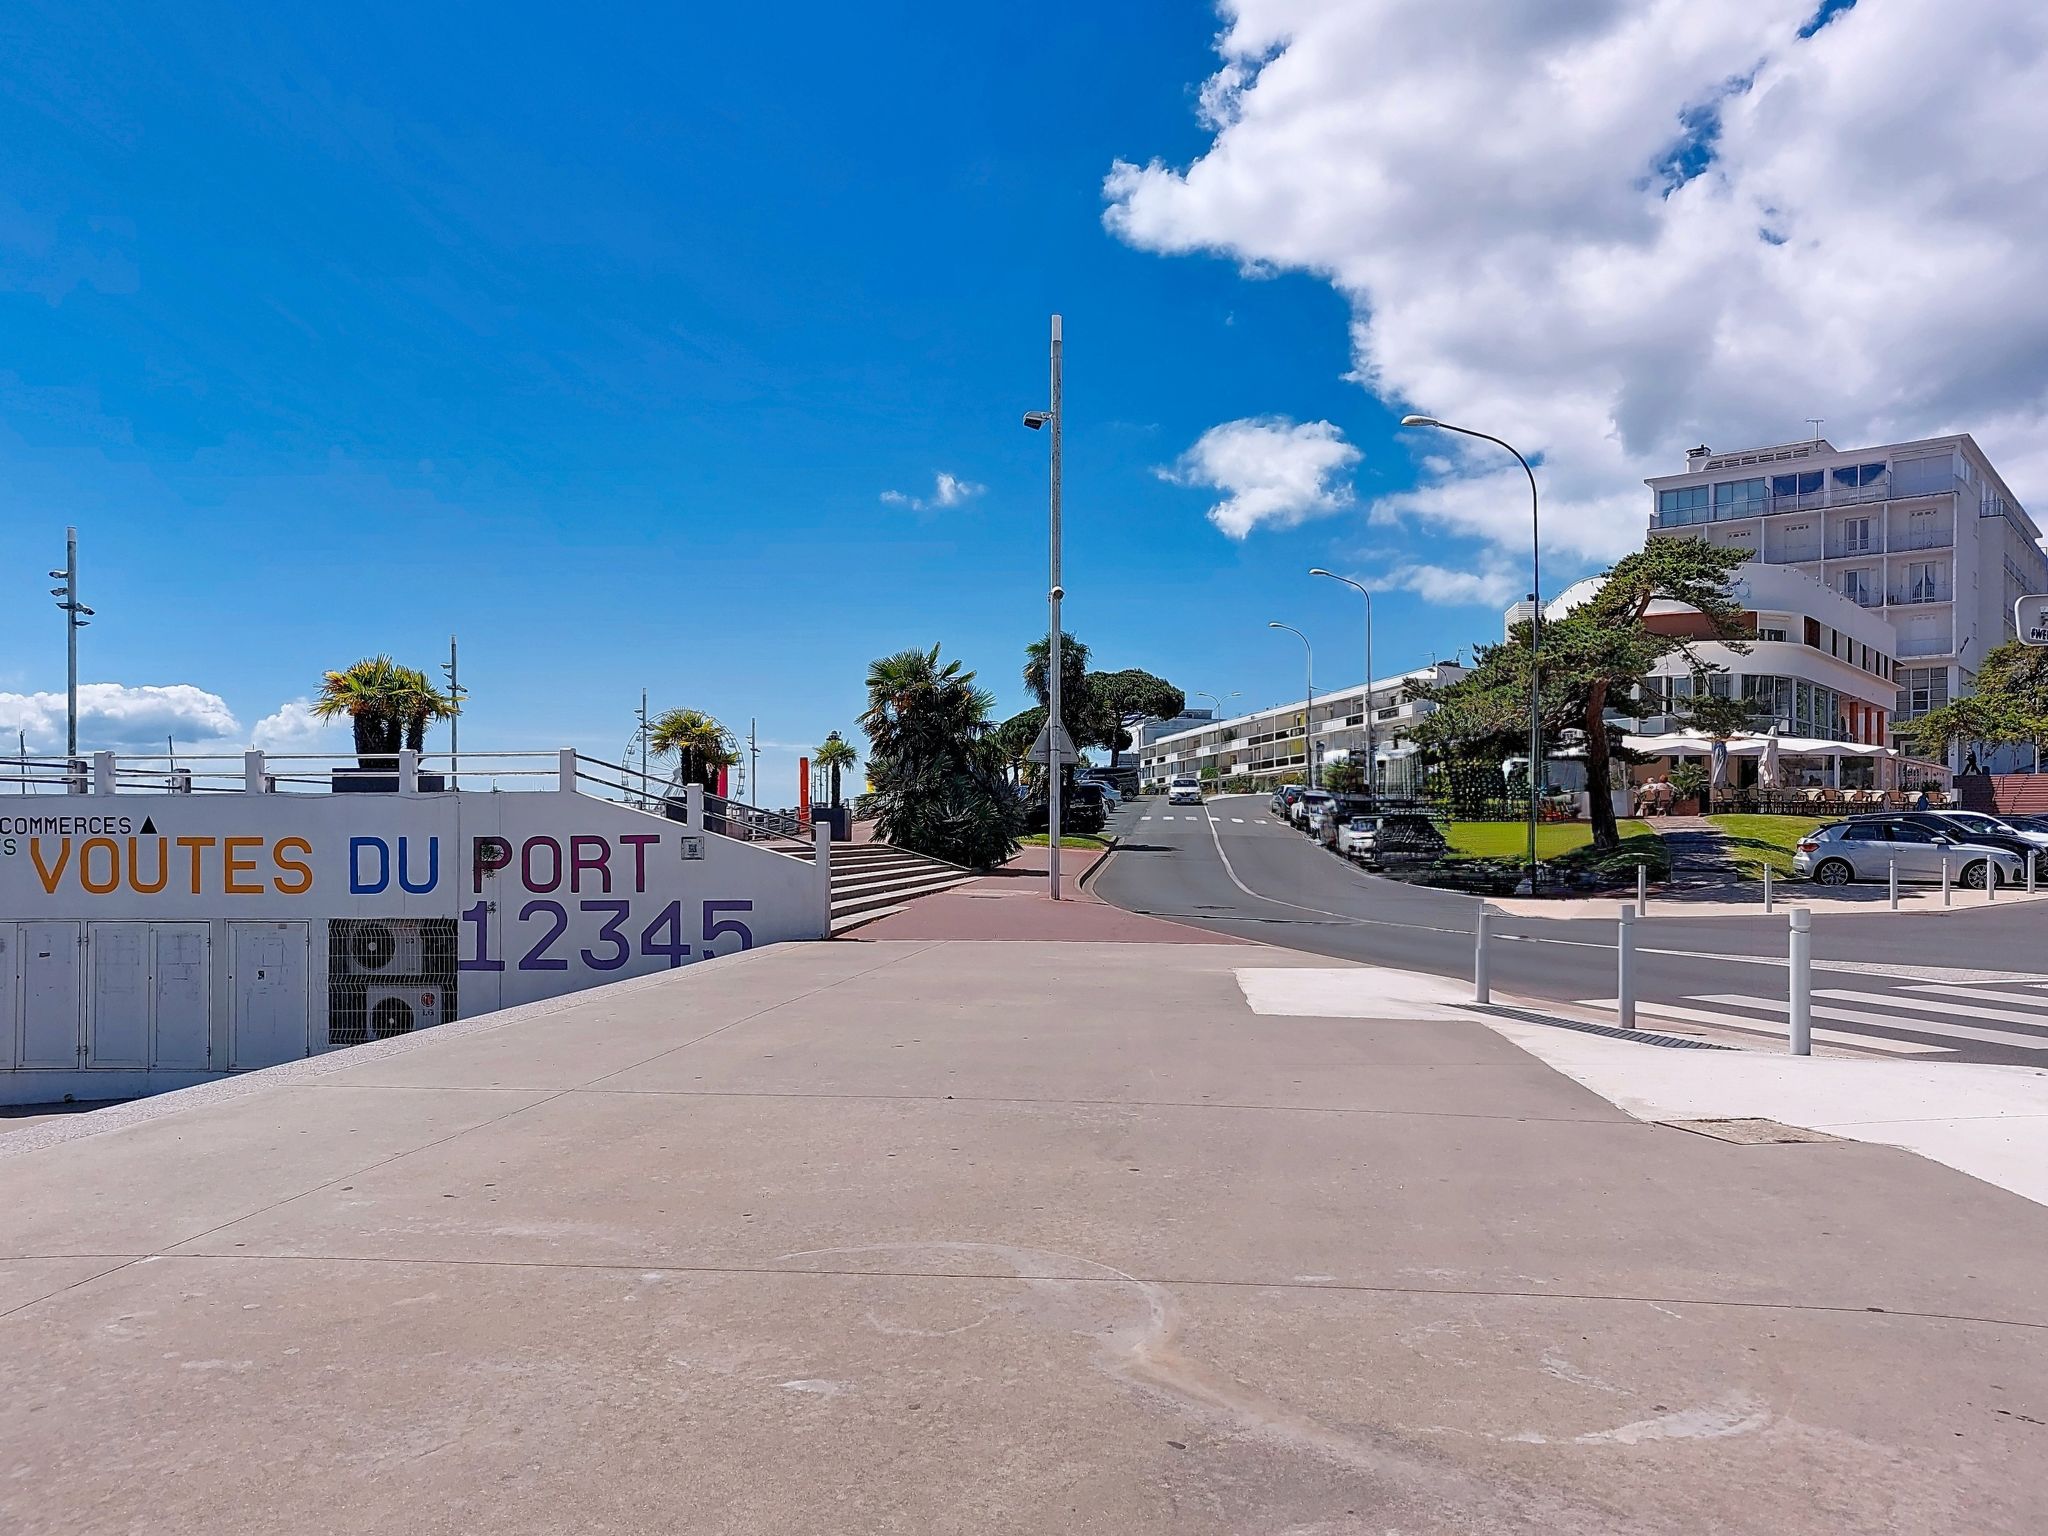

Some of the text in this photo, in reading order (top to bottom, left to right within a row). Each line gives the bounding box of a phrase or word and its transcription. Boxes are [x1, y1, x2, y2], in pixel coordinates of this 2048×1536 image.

[0, 817, 132, 835] COMMERCES
[0, 838, 17, 856] S
[30, 834, 660, 895] VOUTES DU PORT
